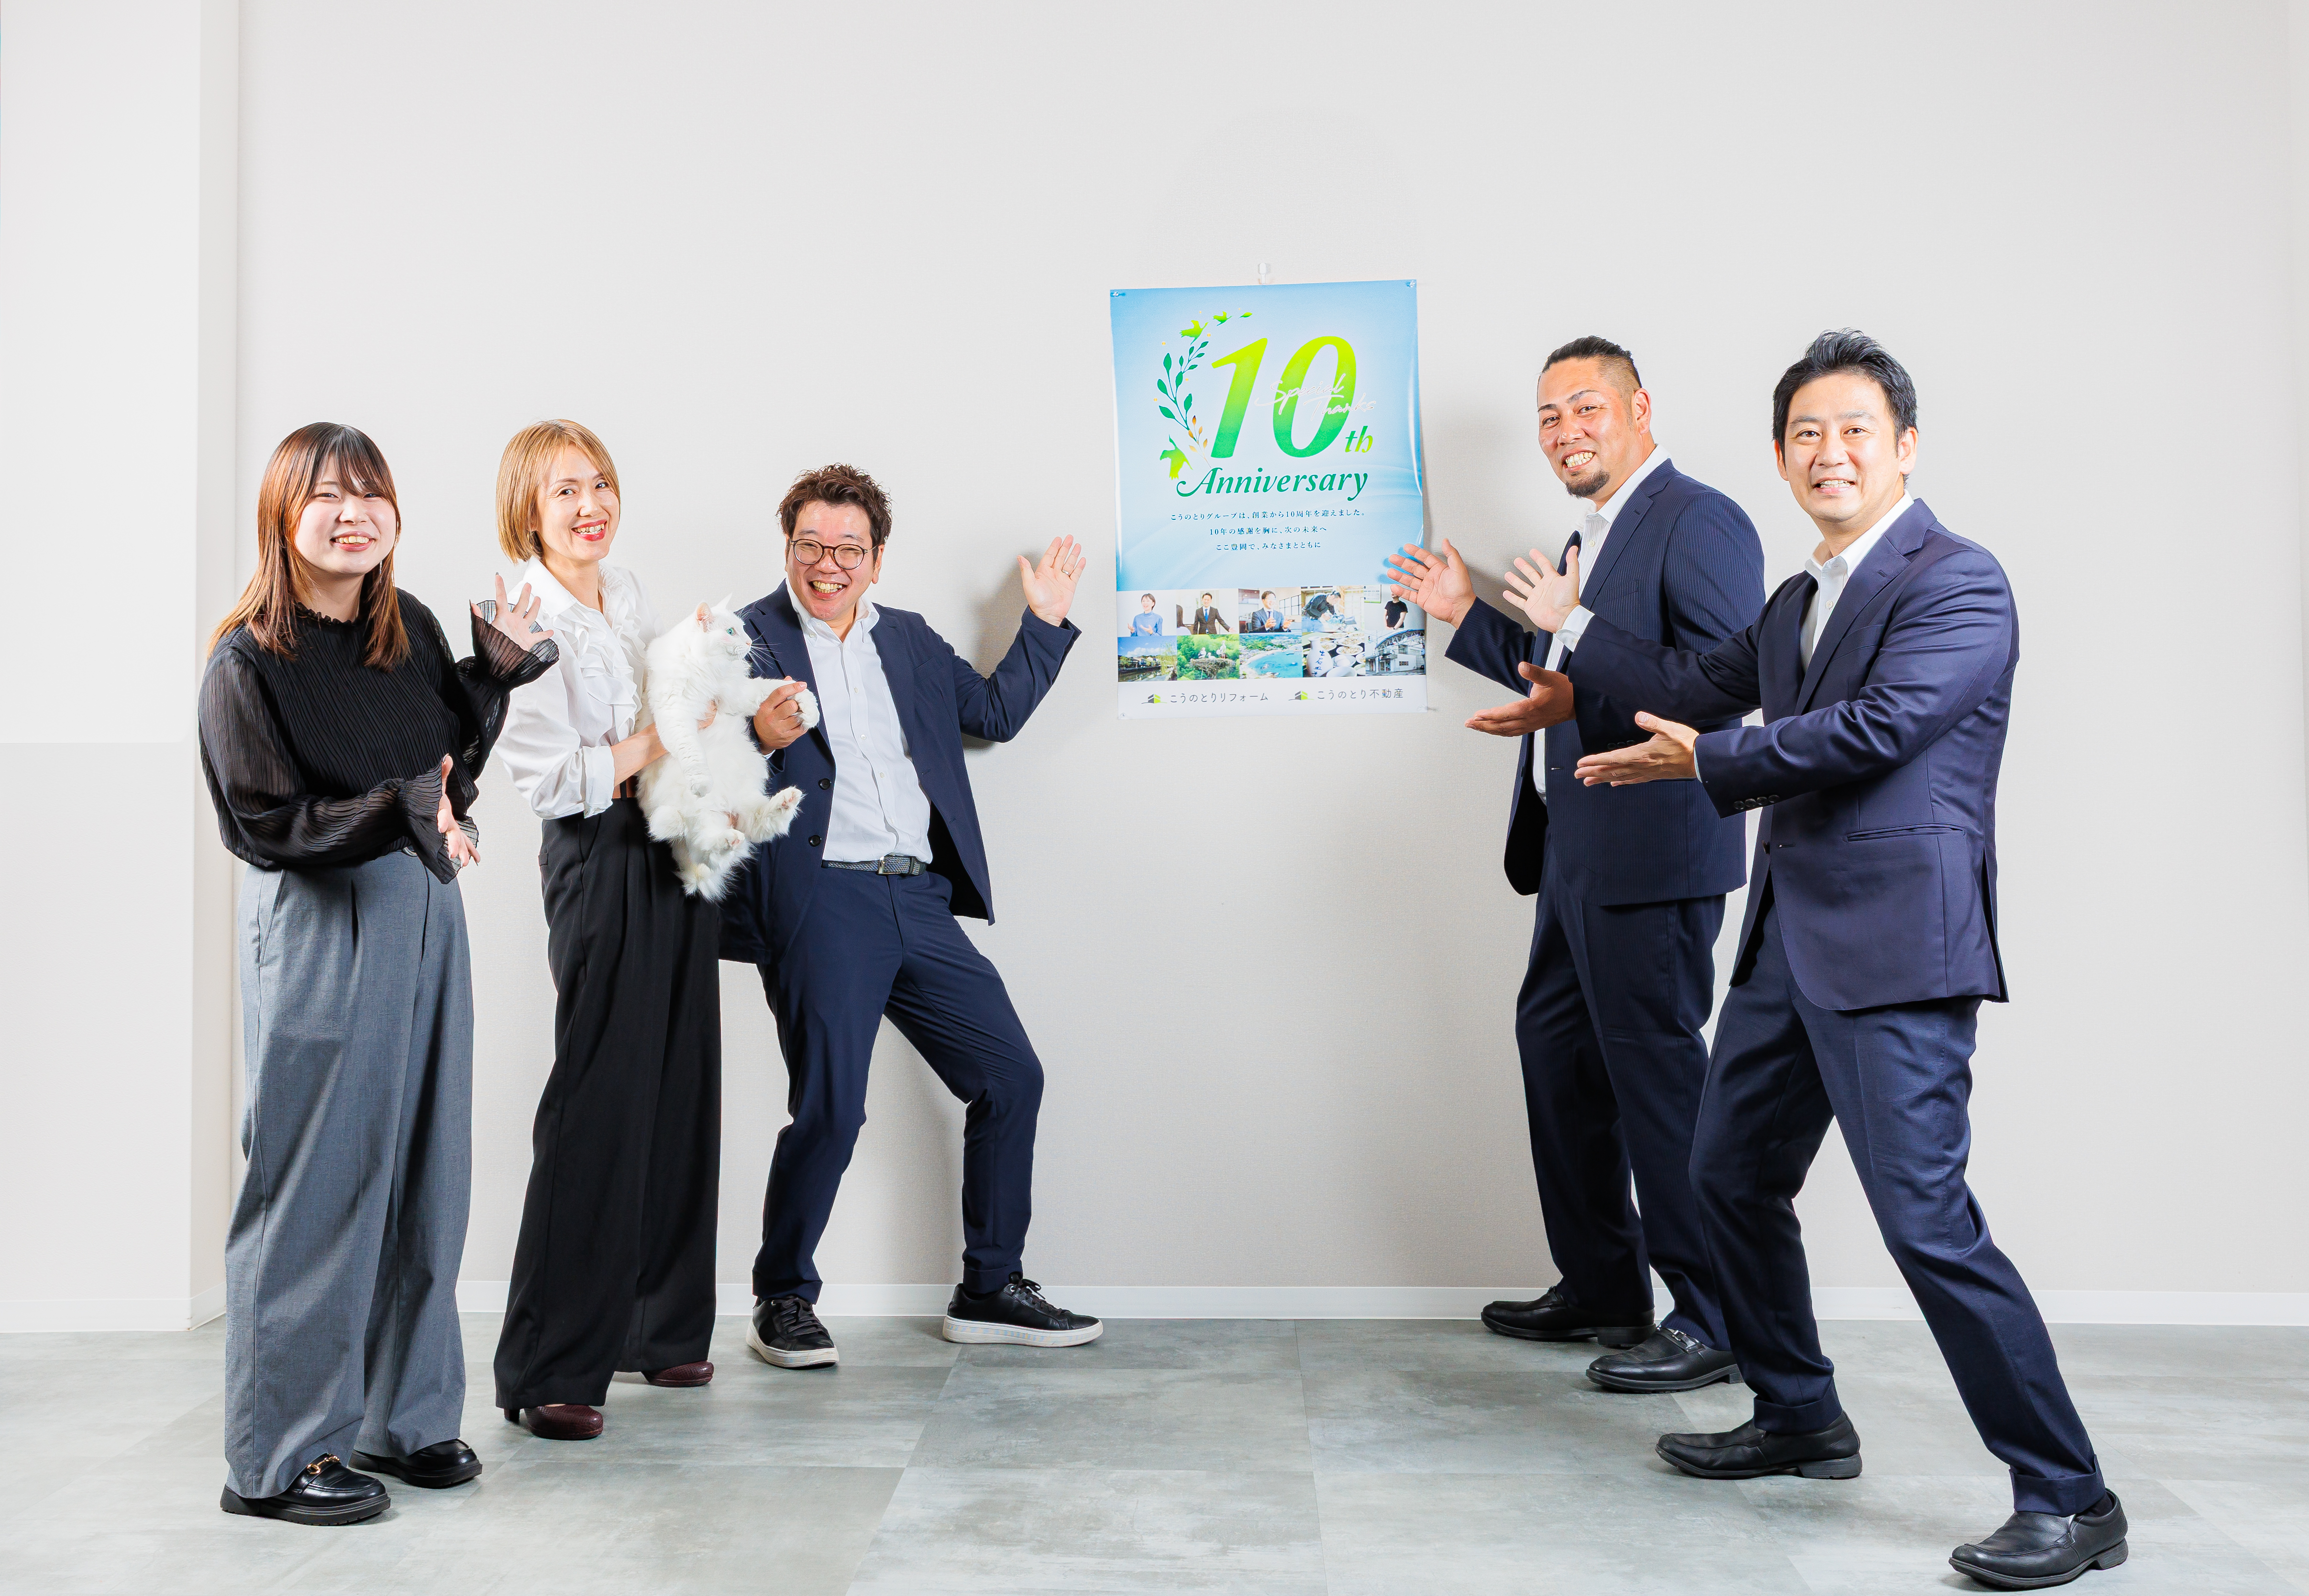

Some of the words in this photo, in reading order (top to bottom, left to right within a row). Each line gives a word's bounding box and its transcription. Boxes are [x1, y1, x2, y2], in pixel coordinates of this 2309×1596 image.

[1254, 373, 1346, 415] Special
[1303, 393, 1376, 421] Thanks
[1177, 467, 1368, 501] Anniversary
[1171, 509, 1365, 520] こうのとりグループは、創業から10周年を迎えました。
[1210, 525, 1327, 535] 10年の感謝を胸に、次の未来へ
[1216, 541, 1321, 550] ここ豊岡で、みなさまとともに
[1170, 693, 1268, 704] こうのとりリフォーム
[1317, 688, 1403, 700] こうのとり不動産
